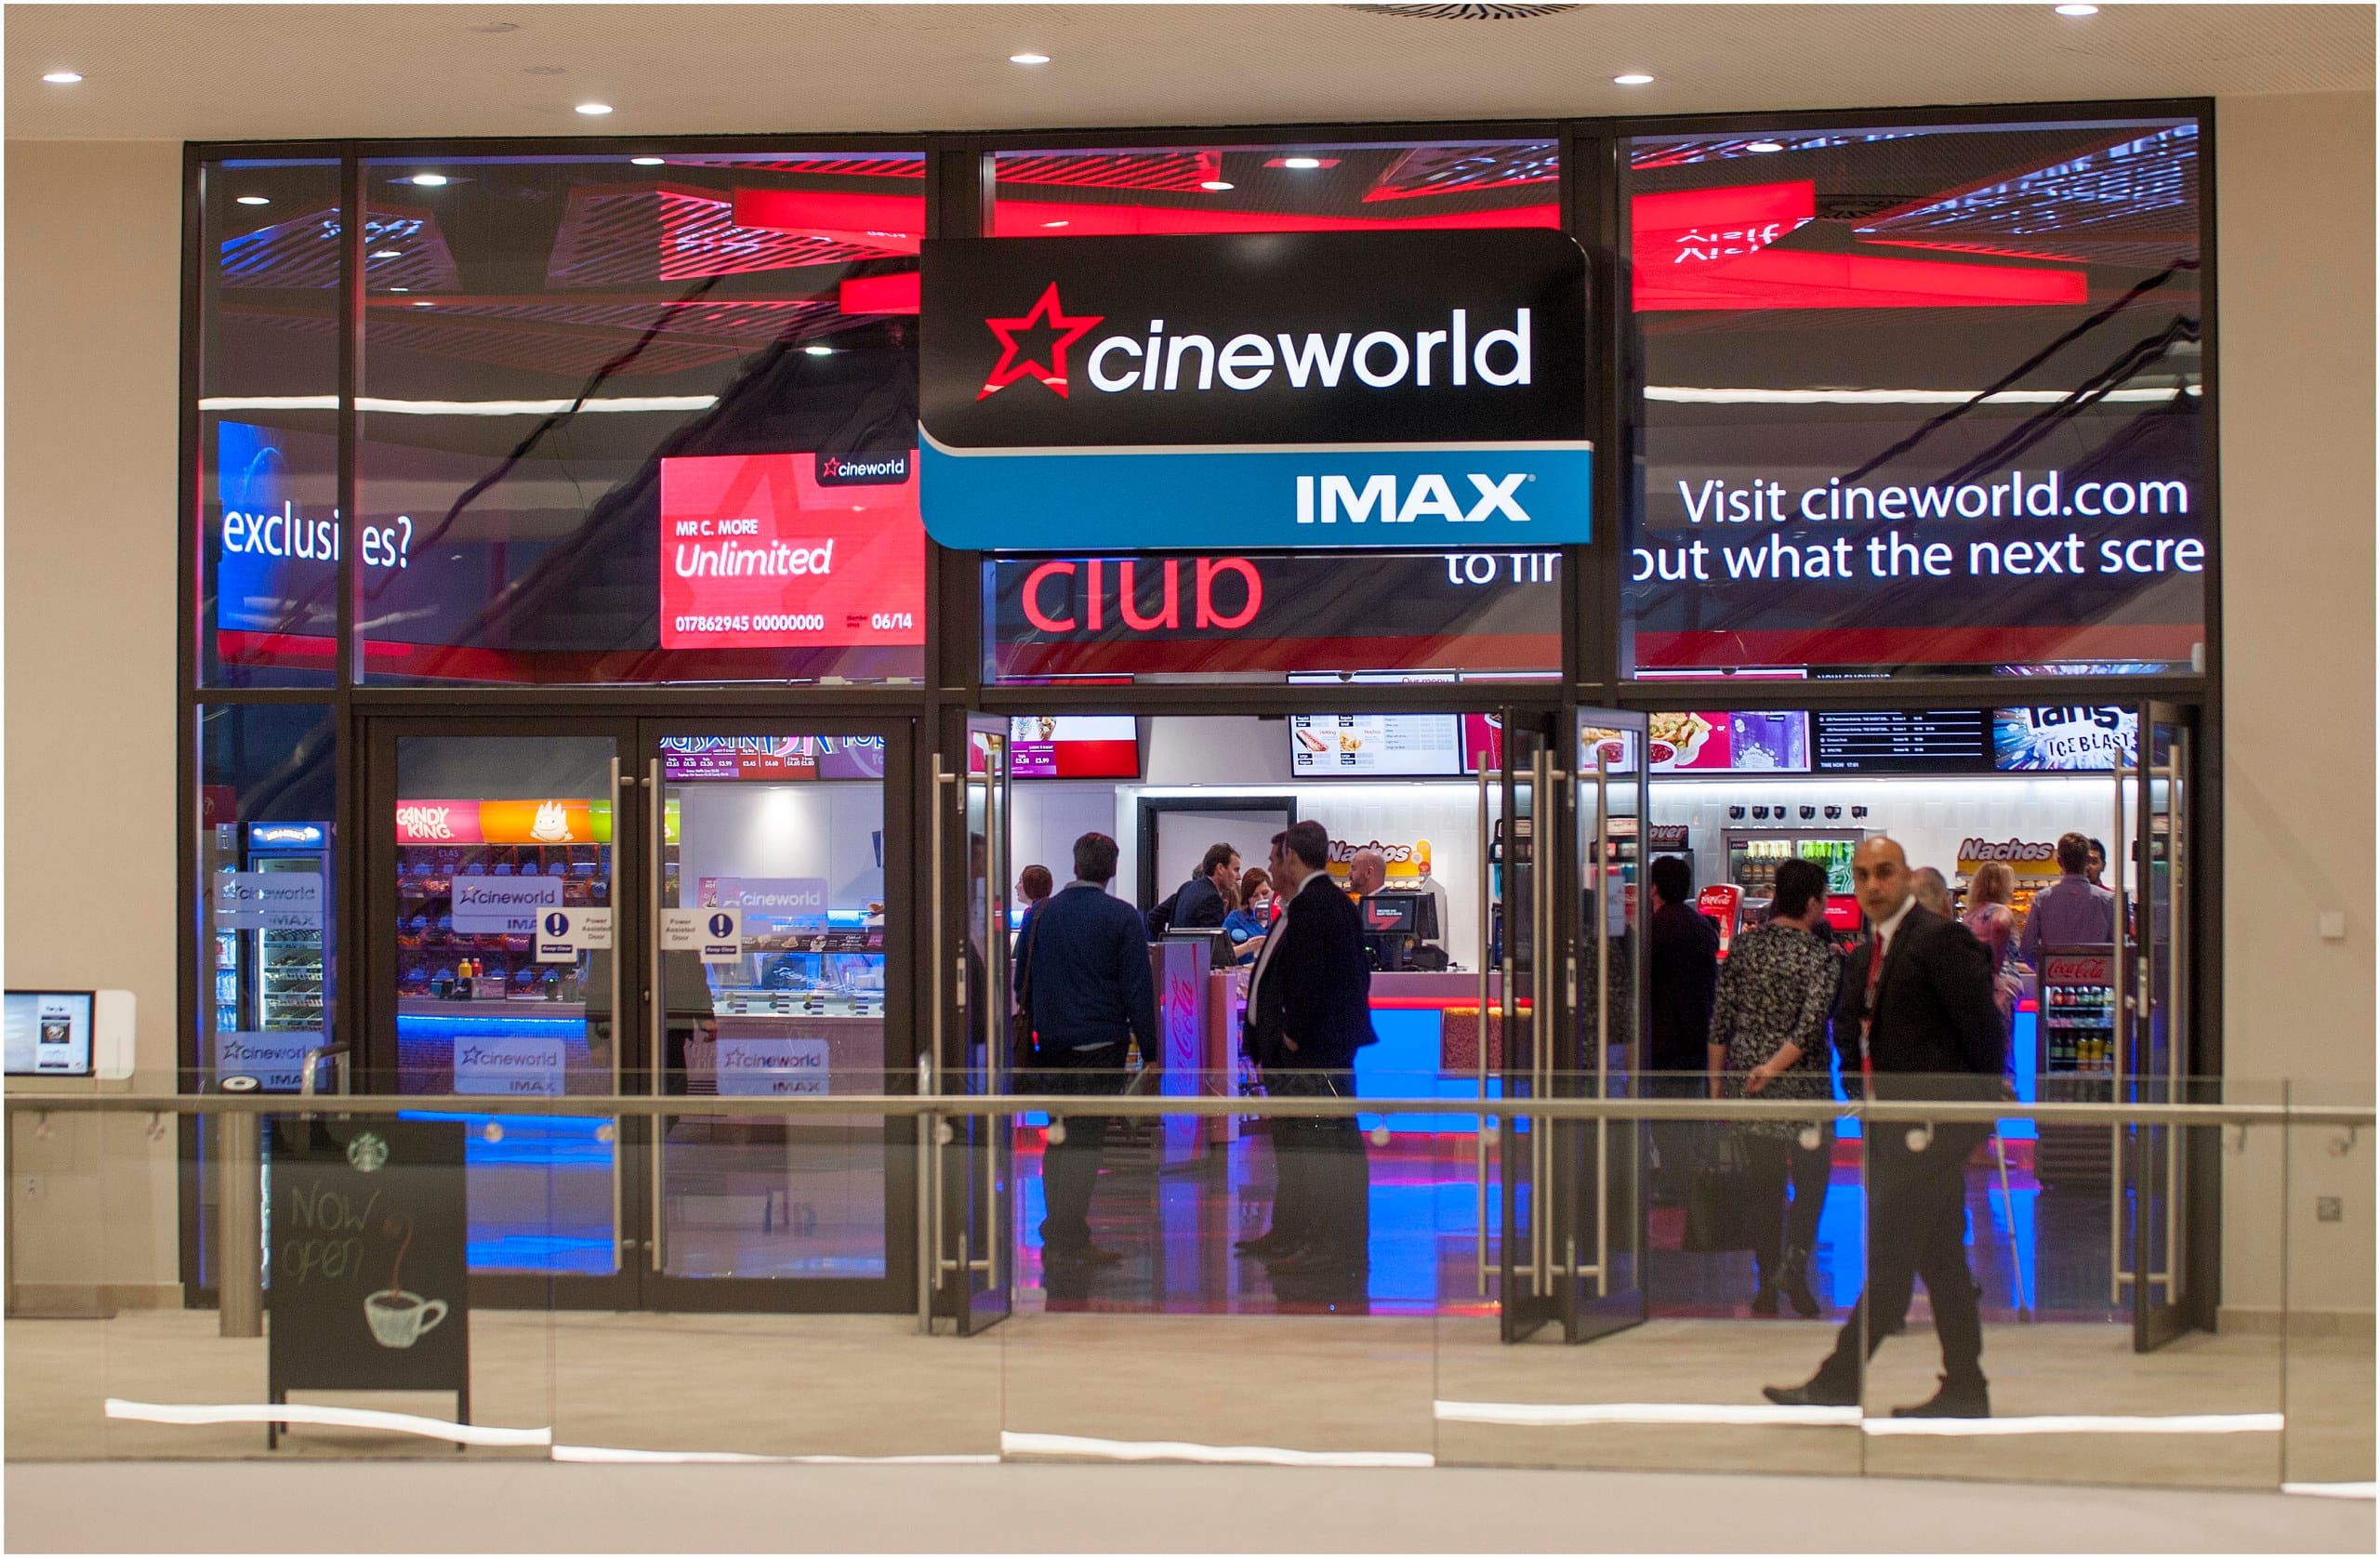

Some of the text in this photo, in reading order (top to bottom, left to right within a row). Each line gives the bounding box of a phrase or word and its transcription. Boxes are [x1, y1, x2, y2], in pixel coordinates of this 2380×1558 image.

[1087, 307, 1532, 392] cineworld
[838, 457, 905, 478] cineworld
[1296, 472, 1531, 524] IMAX
[1677, 469, 2188, 523] Visit cineworld.com
[675, 519, 760, 536] MR C. MORE
[675, 537, 834, 577] Unlimited
[1723, 533, 1853, 579] what
[1866, 530, 1953, 576] the
[1968, 532, 2085, 575] next
[1444, 553, 1497, 585] to
[1022, 558, 1263, 633] club
[675, 614, 825, 632] 017862945 00000000
[871, 612, 914, 630] 06/14
[2078, 732, 2130, 753] BLAST
[396, 805, 450, 825] CANDY
[1958, 838, 2054, 861] Nachos
[478, 890, 556, 904] cineworld
[742, 891, 821, 907] cineworld
[480, 1052, 558, 1066] cineworld
[743, 1052, 821, 1068] cineworld
